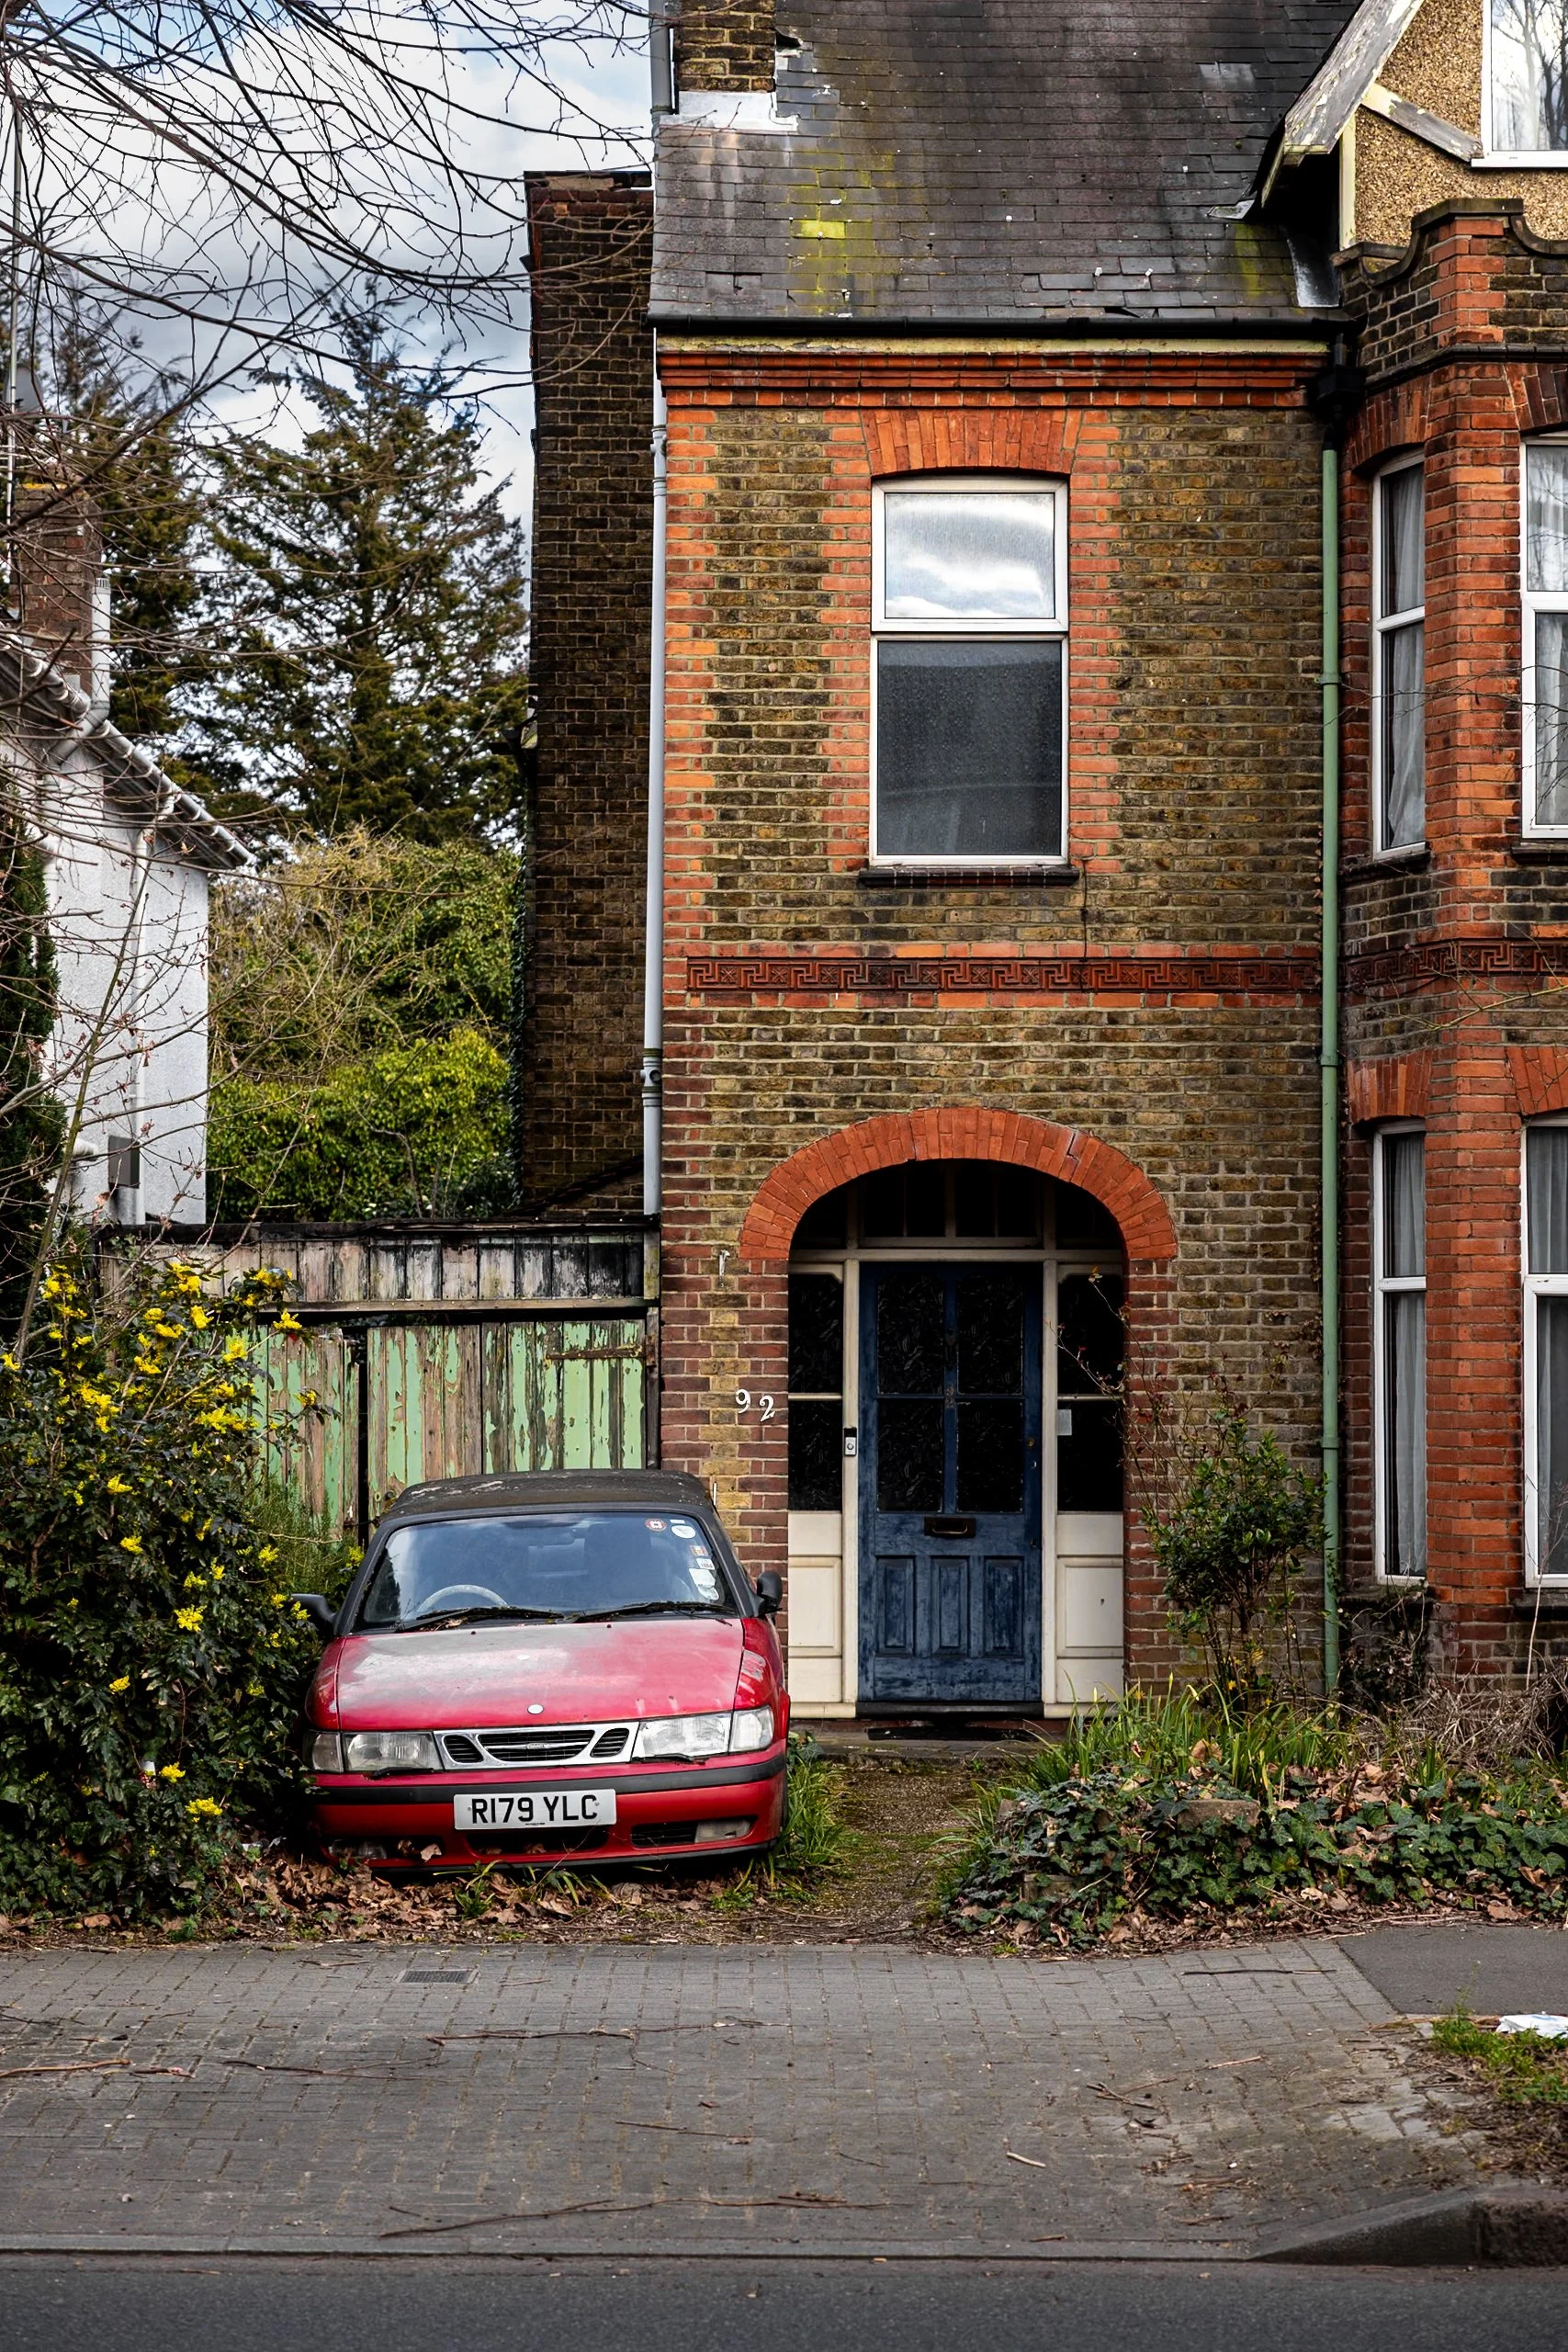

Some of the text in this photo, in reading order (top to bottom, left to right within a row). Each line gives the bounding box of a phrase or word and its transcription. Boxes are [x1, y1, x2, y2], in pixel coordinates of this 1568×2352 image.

[735, 1388, 775, 1422] 92
[471, 1794, 598, 1824] R179 YLC
